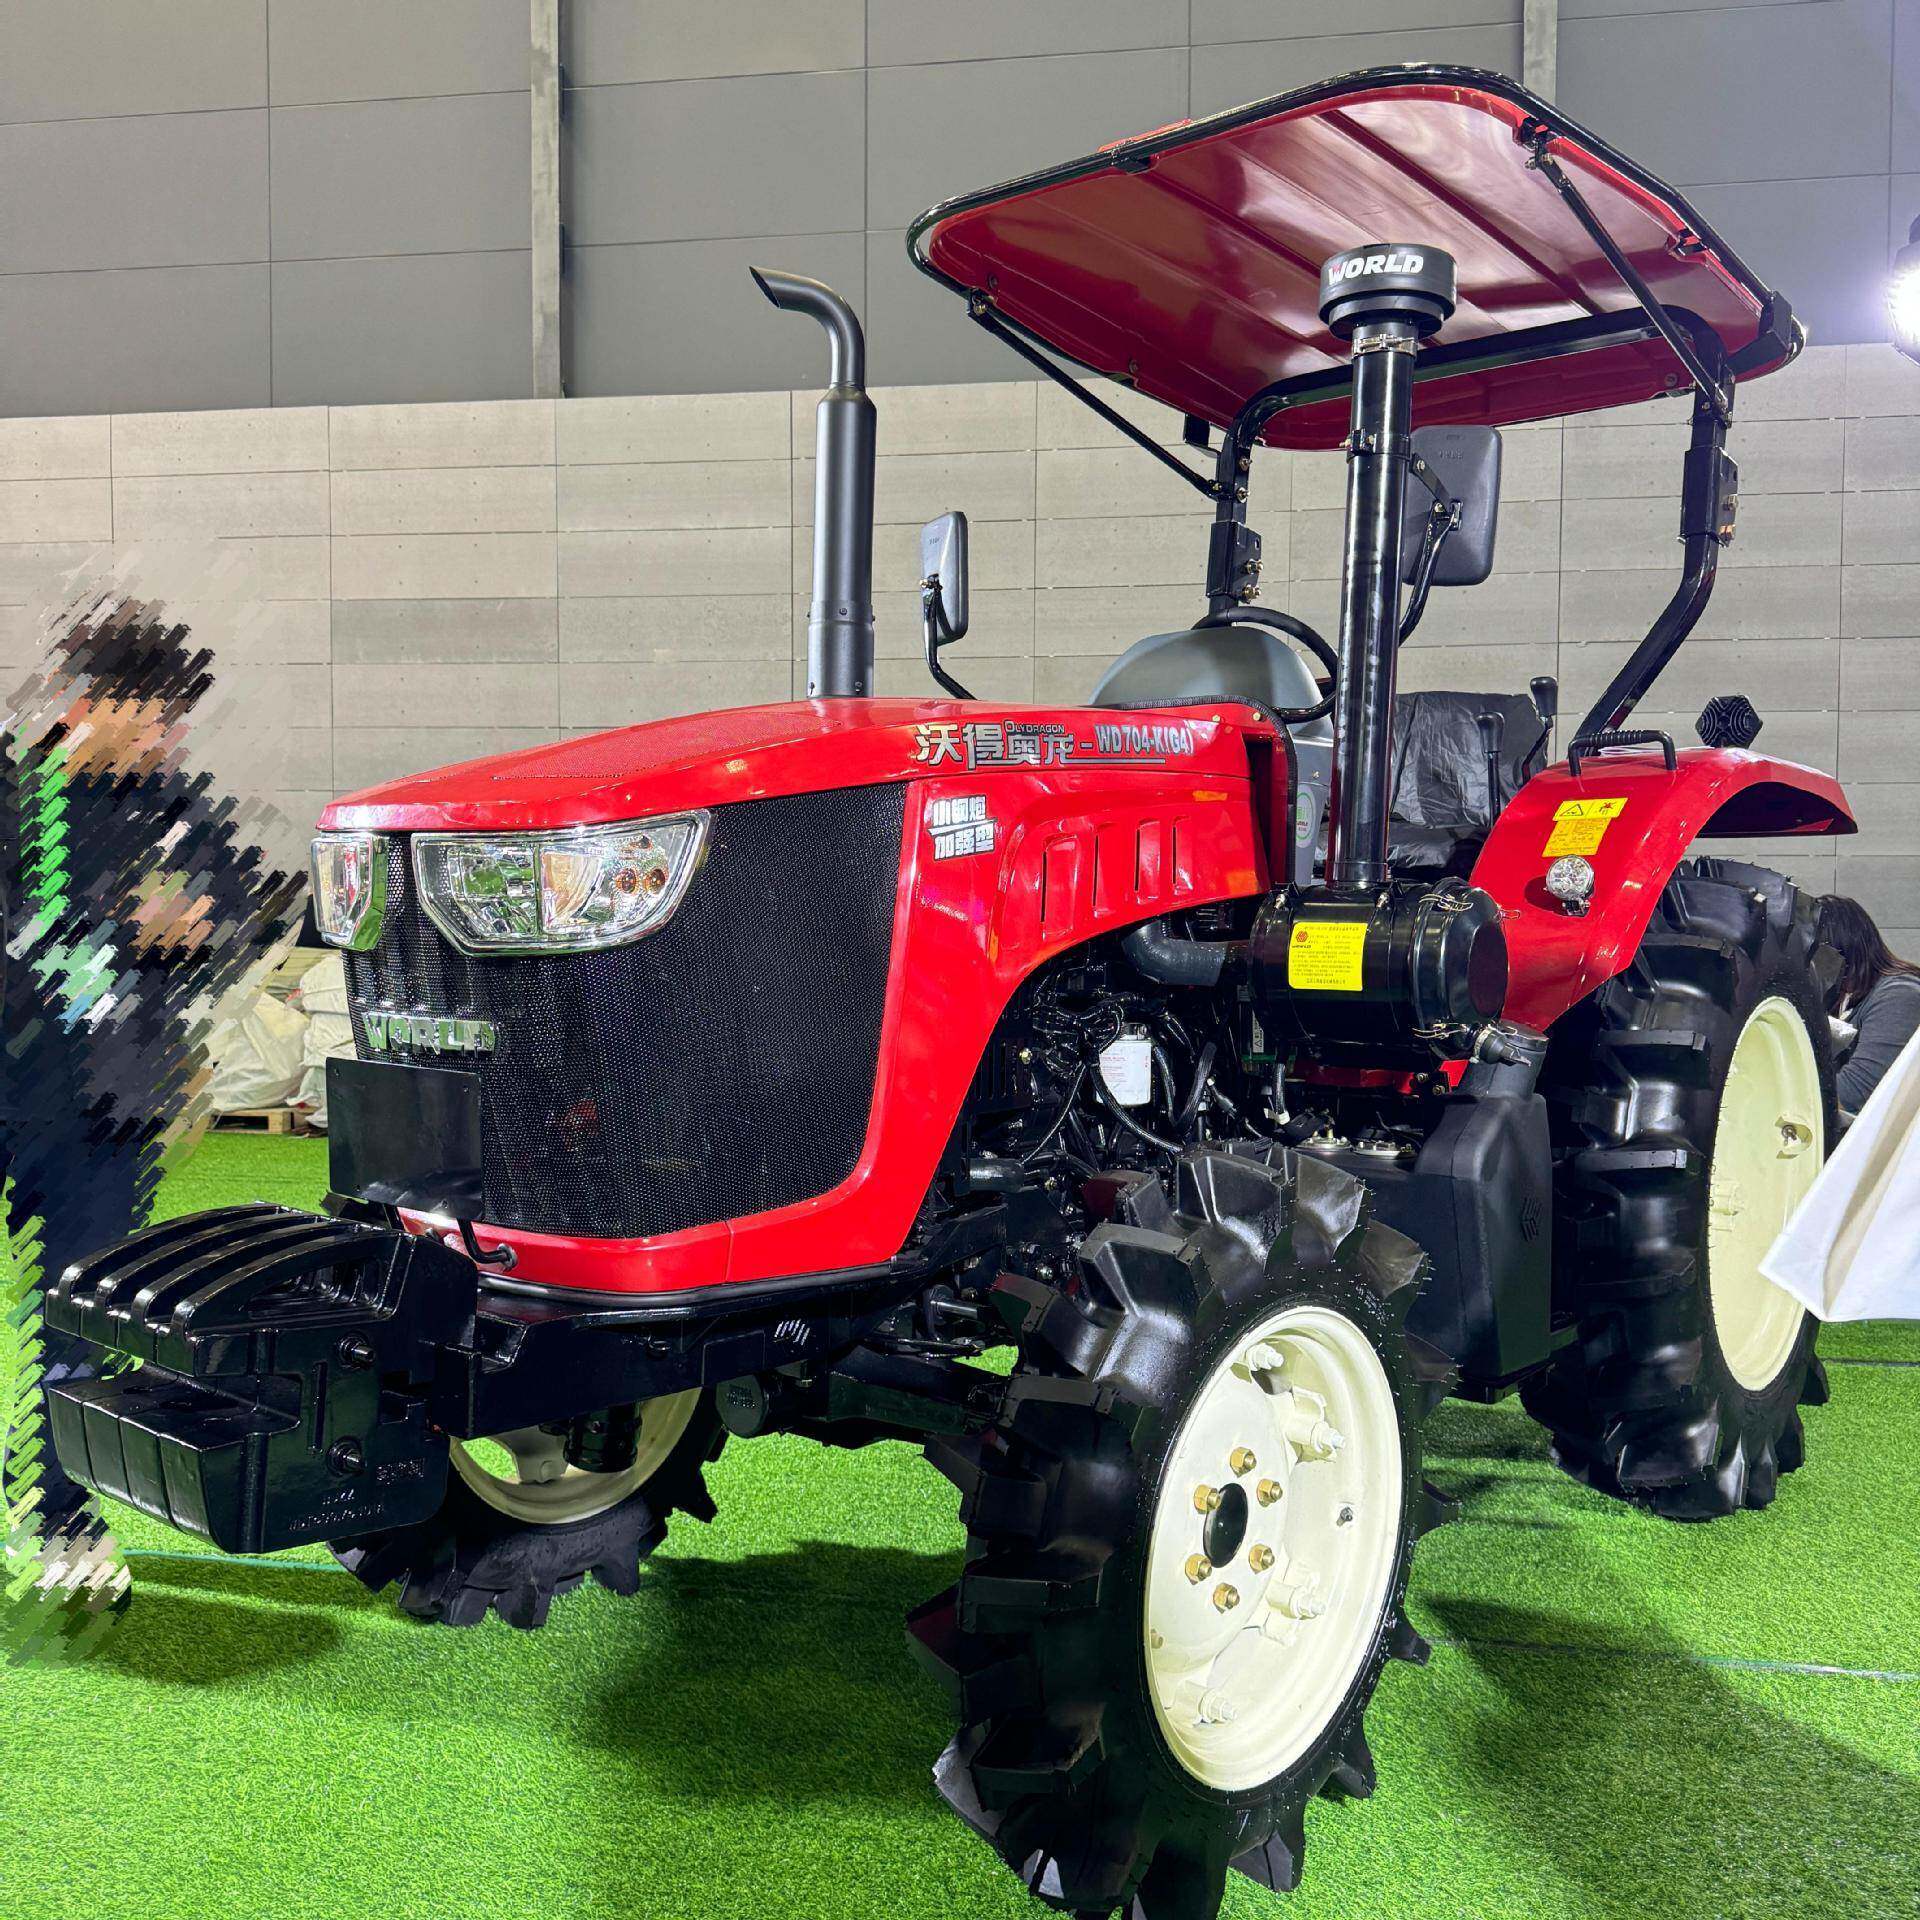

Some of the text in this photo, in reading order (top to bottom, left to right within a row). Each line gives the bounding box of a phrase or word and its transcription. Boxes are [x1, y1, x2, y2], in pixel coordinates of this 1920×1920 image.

[1328, 254, 1424, 286] WORLD
[1004, 720, 1065, 733] OLYDRAGON
[933, 822, 995, 861] 加强型
[361, 1010, 496, 1056] WORLD
